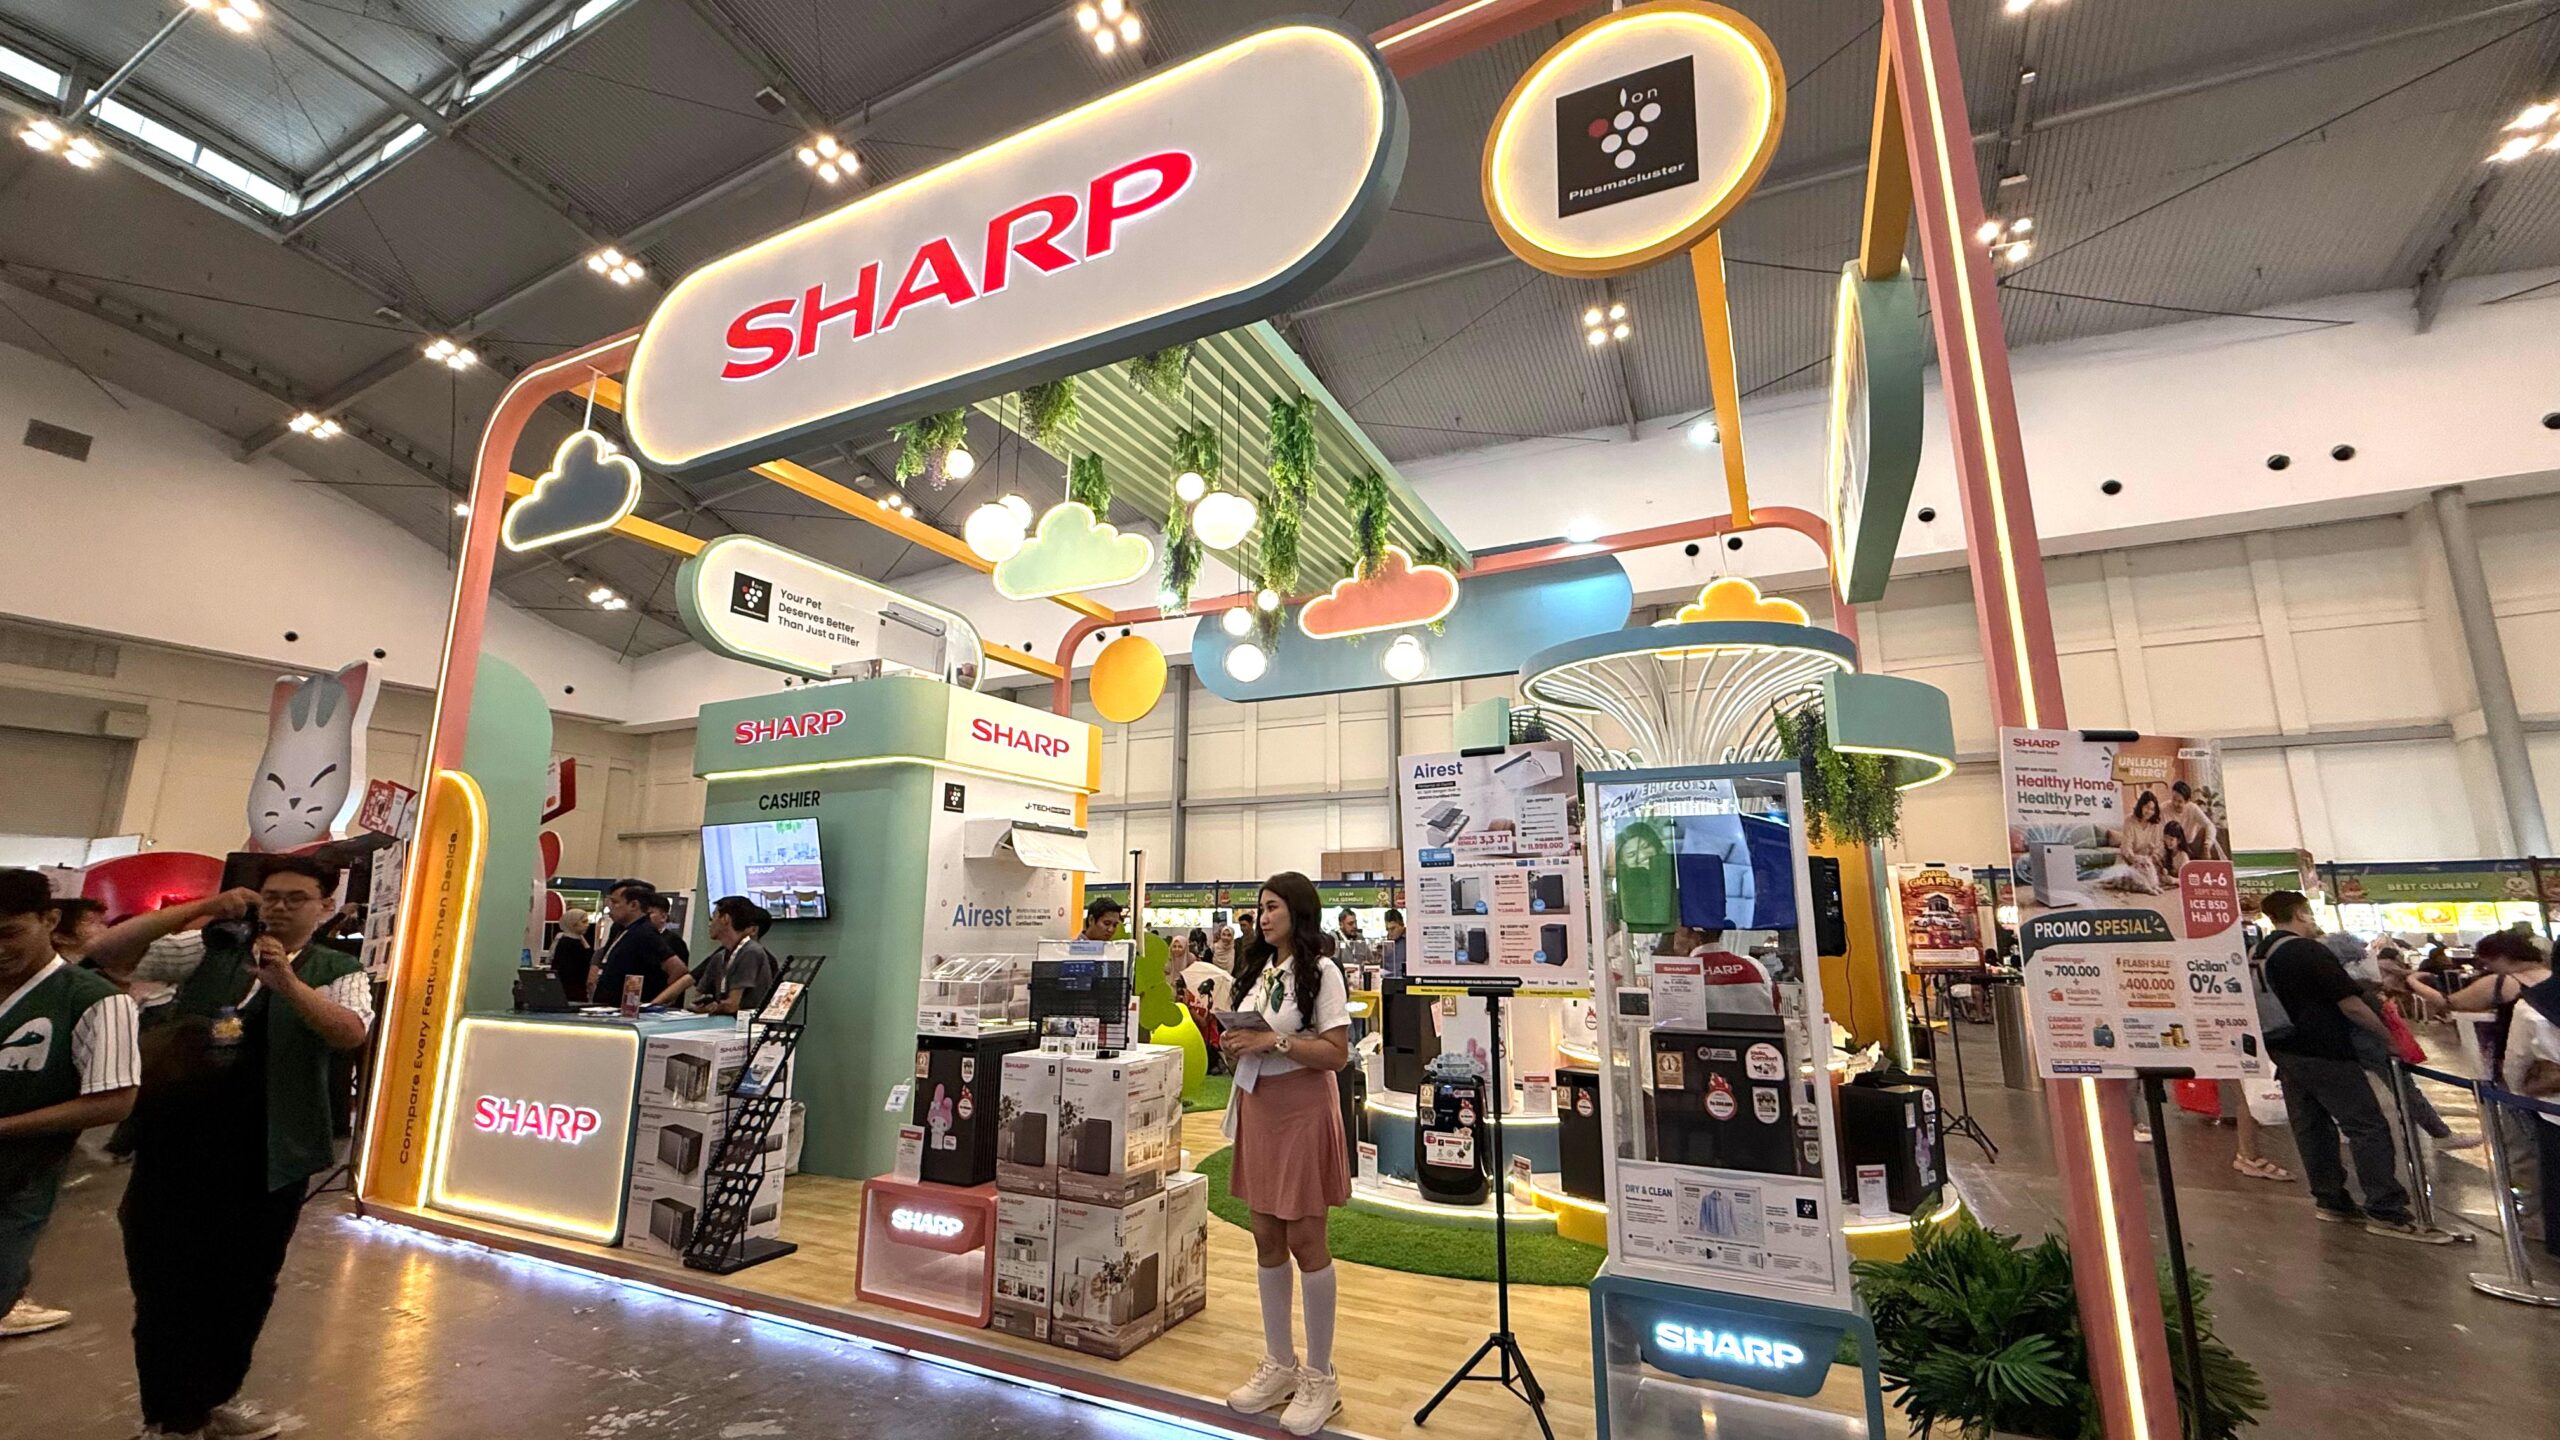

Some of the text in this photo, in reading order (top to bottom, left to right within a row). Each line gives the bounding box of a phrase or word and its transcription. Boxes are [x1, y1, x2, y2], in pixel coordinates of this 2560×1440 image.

[1569, 162, 1685, 200] Plasmacluster
[720, 150, 1199, 382] SHARP
[780, 588, 822, 610] Your Pet
[778, 602, 825, 624] Deserves
[826, 616, 855, 633] Better
[778, 615, 804, 631] Than
[805, 624, 827, 638] Just
[836, 633, 860, 648] Filter
[734, 708, 847, 745] SHARP
[971, 718, 1070, 757] SHARP
[2012, 737, 2060, 749] SHARP
[1413, 761, 1464, 779] Airest
[2118, 756, 2168, 769] UNLEASH
[2129, 766, 2168, 779] ENERGY
[2016, 774, 2118, 793] Healthy Home,
[758, 790, 821, 811] CASHIER
[1025, 802, 1051, 811] J-TECH
[2017, 791, 2097, 810] Healthy Pet
[1479, 834, 1510, 845] 3,3 JT
[748, 866, 776, 875] SHARP
[1920, 870, 1947, 878] SHARP
[1909, 877, 1962, 887] GIGA FEST
[2202, 872, 2228, 886] 4-6
[2387, 881, 2479, 891] BEST CULINARY
[2190, 900, 2228, 910] ICE BSD
[434, 897, 448, 939] Then
[952, 902, 1012, 927] Airest
[2191, 911, 2230, 924] Hall 10
[2034, 918, 2151, 939] PROMO SPESIAL
[2054, 965, 2101, 977] 700.000
[2123, 960, 2171, 969] FLASH SALE
[421, 944, 442, 1016] Feature.
[2126, 978, 2175, 991] 400.000
[2189, 973, 2222, 994] 0%
[2215, 1019, 2226, 1028] Rp
[414, 1020, 430, 1066] Every
[1005, 1062, 1030, 1070] SHARP
[1066, 1066, 1092, 1074] SHARP
[400, 1073, 420, 1164] Compare
[474, 1094, 602, 1145] SHARP
[1624, 1183, 1673, 1198] DRY & CLEAN
[1000, 1197, 1025, 1206] SHARP
[1060, 1207, 1088, 1217] SHARP
[1125, 1208, 1146, 1221] SHARP
[891, 1208, 965, 1237] SHARP
[1654, 1321, 1805, 1370] SHARP
